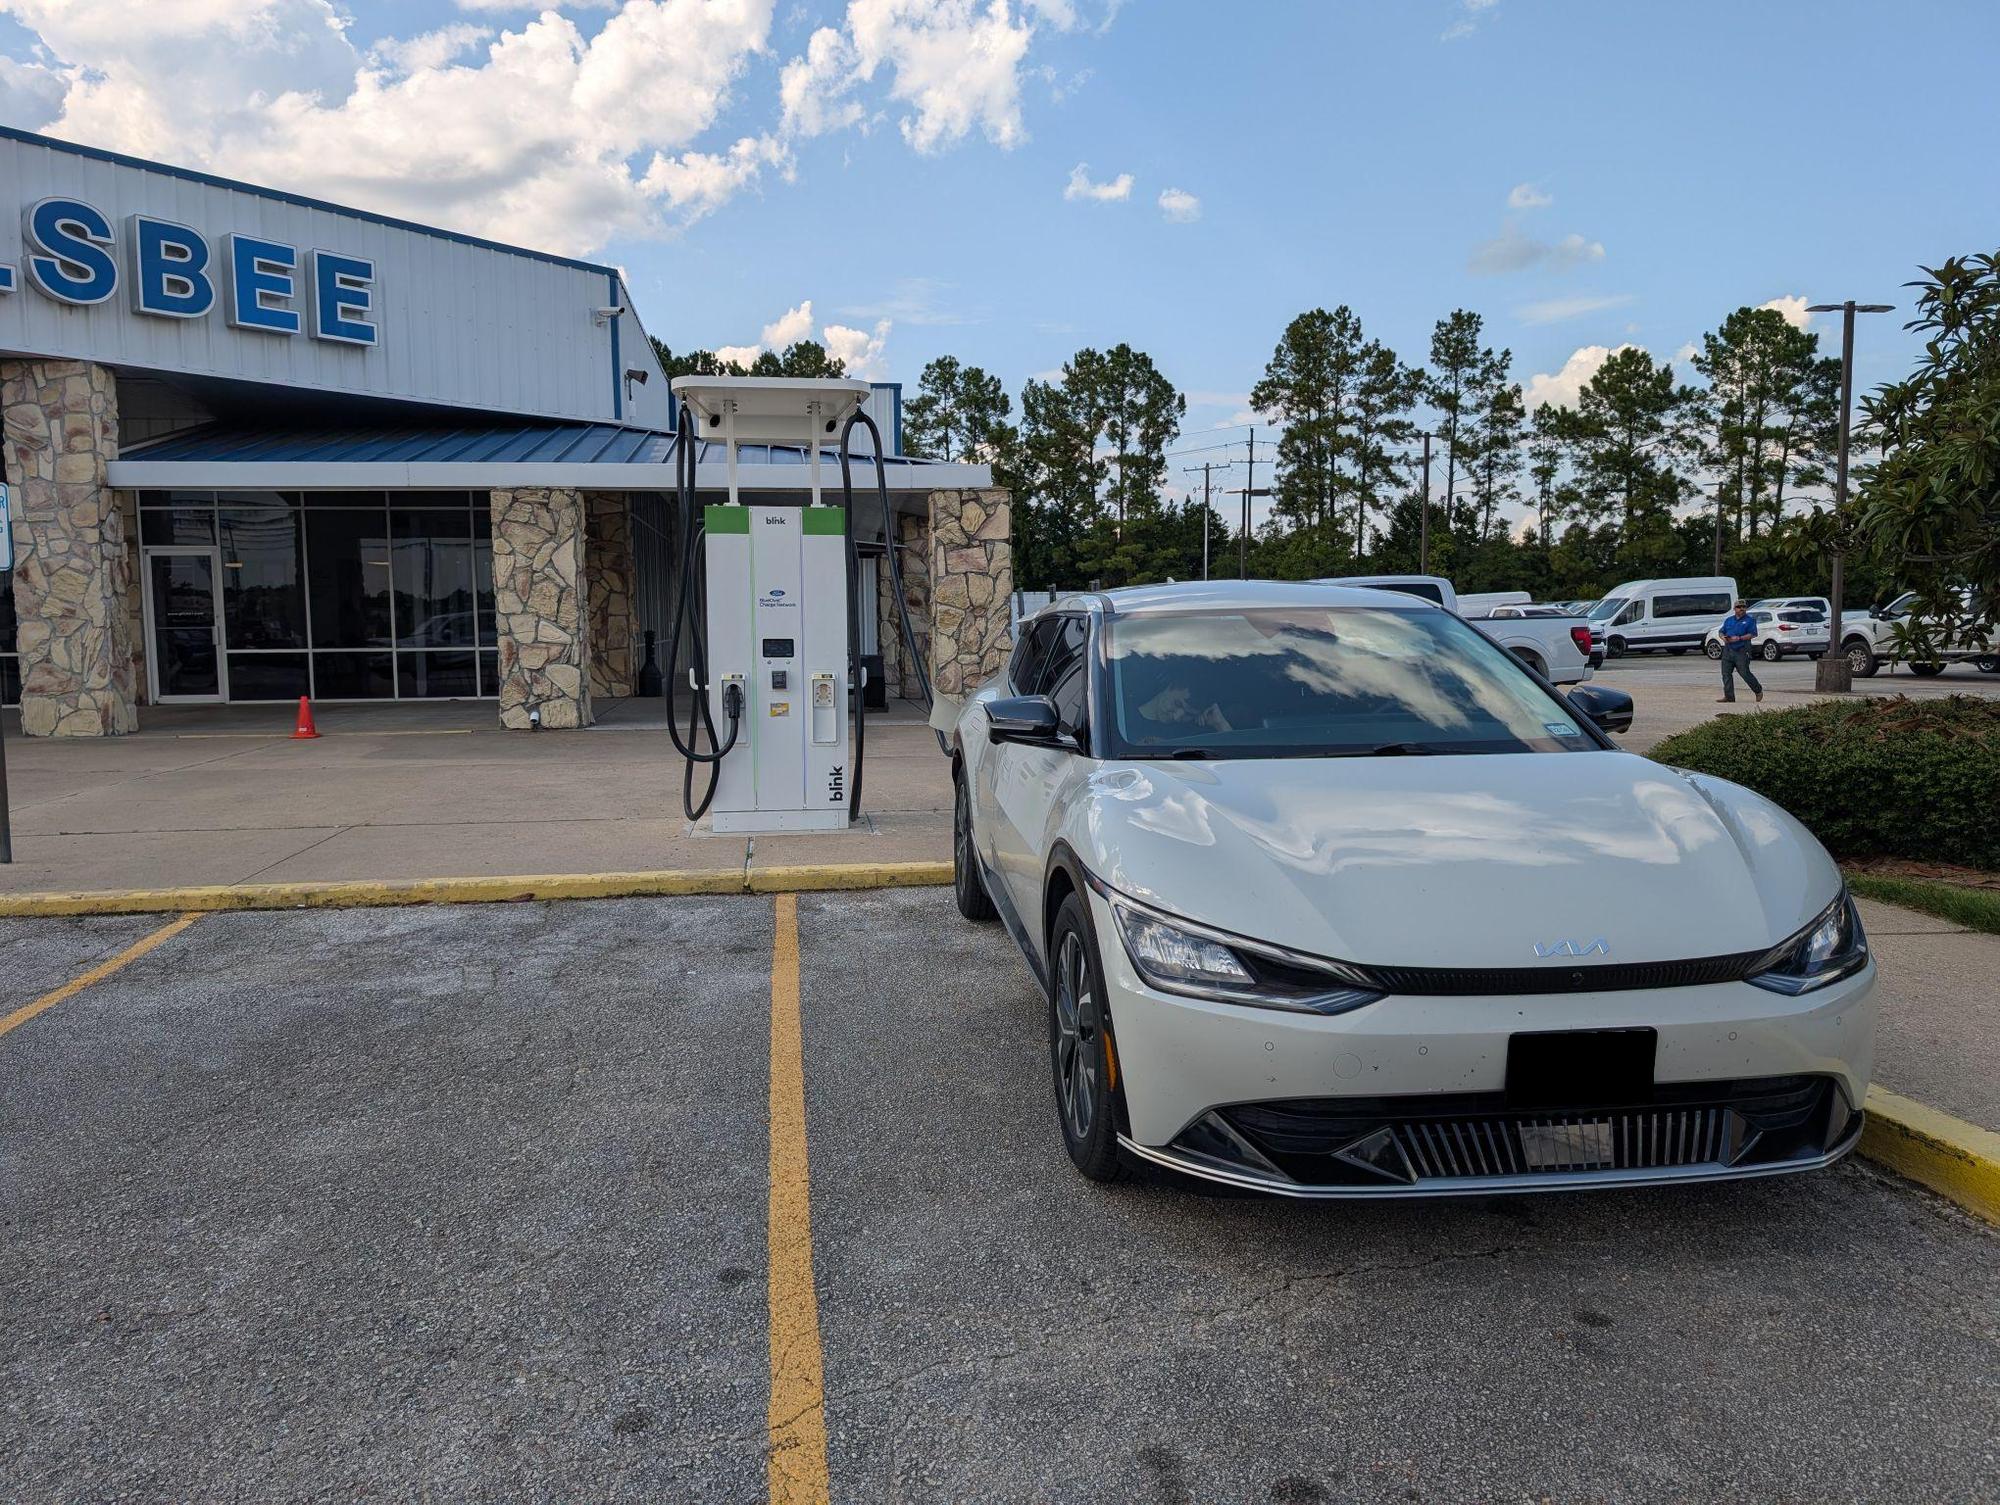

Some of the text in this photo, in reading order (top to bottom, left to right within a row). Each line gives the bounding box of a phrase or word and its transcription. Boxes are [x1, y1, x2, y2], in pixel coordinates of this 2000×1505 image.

[0, 195, 378, 346] SBEE
[766, 516, 786, 525] blink
[829, 766, 843, 801] blink
